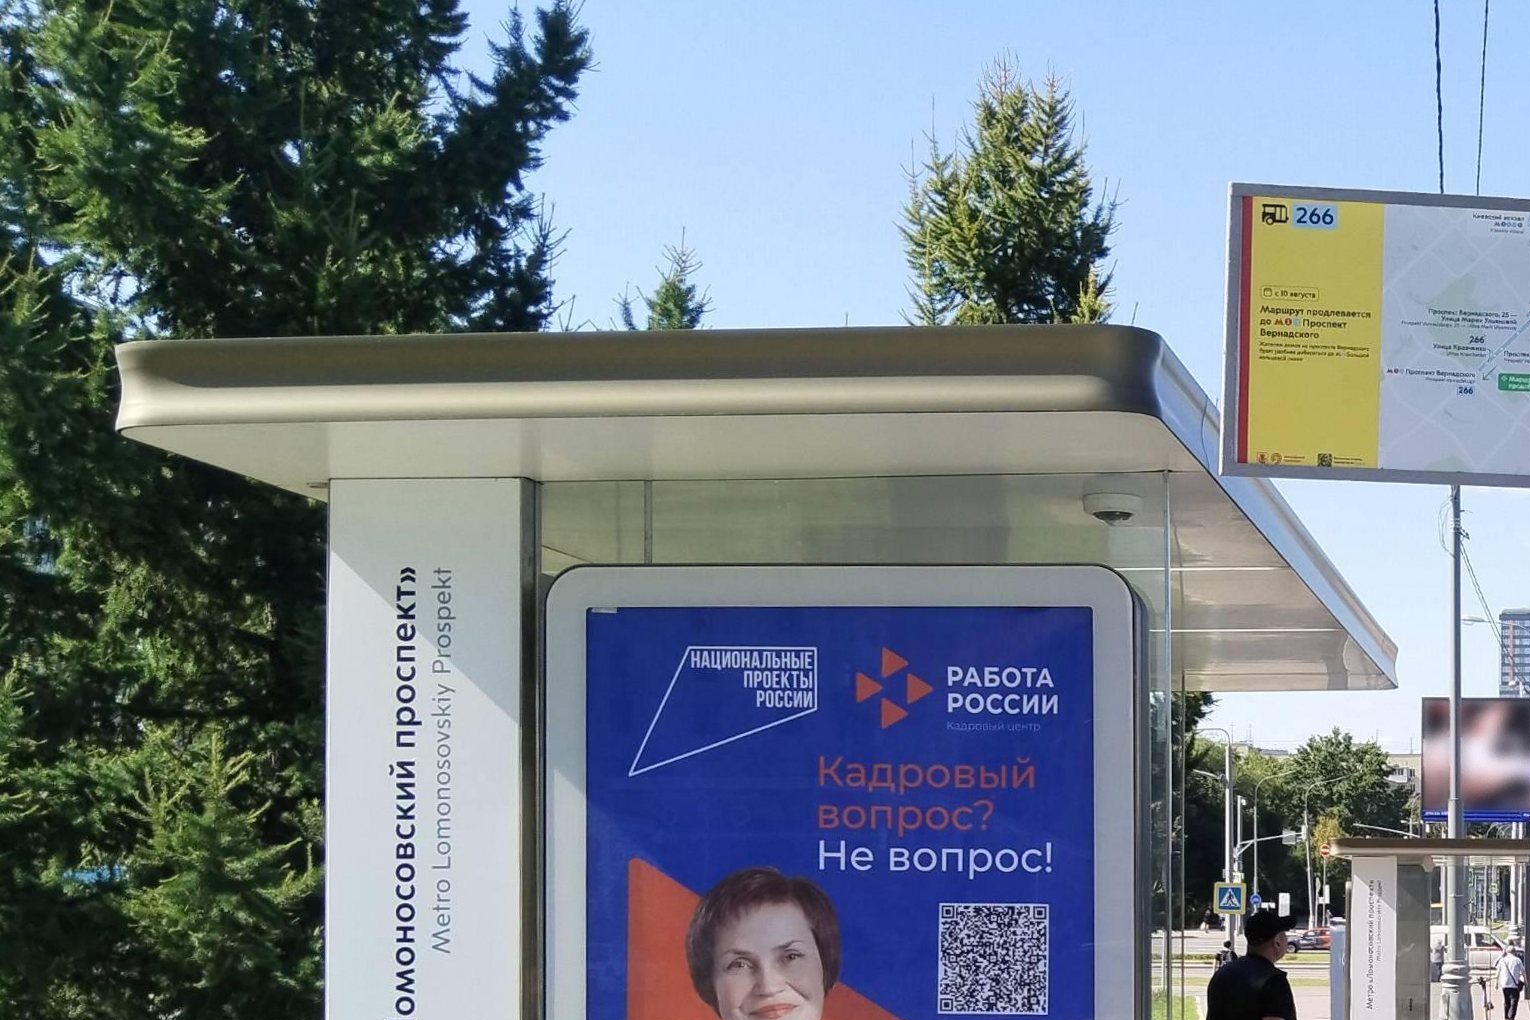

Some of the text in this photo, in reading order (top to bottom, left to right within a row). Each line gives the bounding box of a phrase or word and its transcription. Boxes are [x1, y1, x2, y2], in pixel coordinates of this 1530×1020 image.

[1296, 206, 1334, 225] 266
[1290, 291, 1316, 299] августа
[1260, 305, 1371, 319] Маршрут продлевается
[1302, 319, 1347, 329] Проспект
[1260, 328, 1319, 339] Вернадского
[1469, 336, 1485, 344] 266
[1458, 386, 1474, 394] 266
[396, 566, 422, 747] проспект»
[690, 650, 813, 670] НАЦИОНАЛЬНЫЕ
[743, 671, 813, 689] ПРОЕКТЫ
[947, 666, 1054, 688] РАБОТА
[756, 690, 813, 708] РОССИИ
[947, 692, 1059, 714] РОССИИ
[946, 721, 1041, 732] Кадровый центр
[431, 567, 456, 953] Metro Lomonosovskiy Prospekt
[818, 755, 1036, 795] Кадровый
[818, 799, 995, 837] вопрос?
[818, 840, 1053, 880] Не вопрос!
